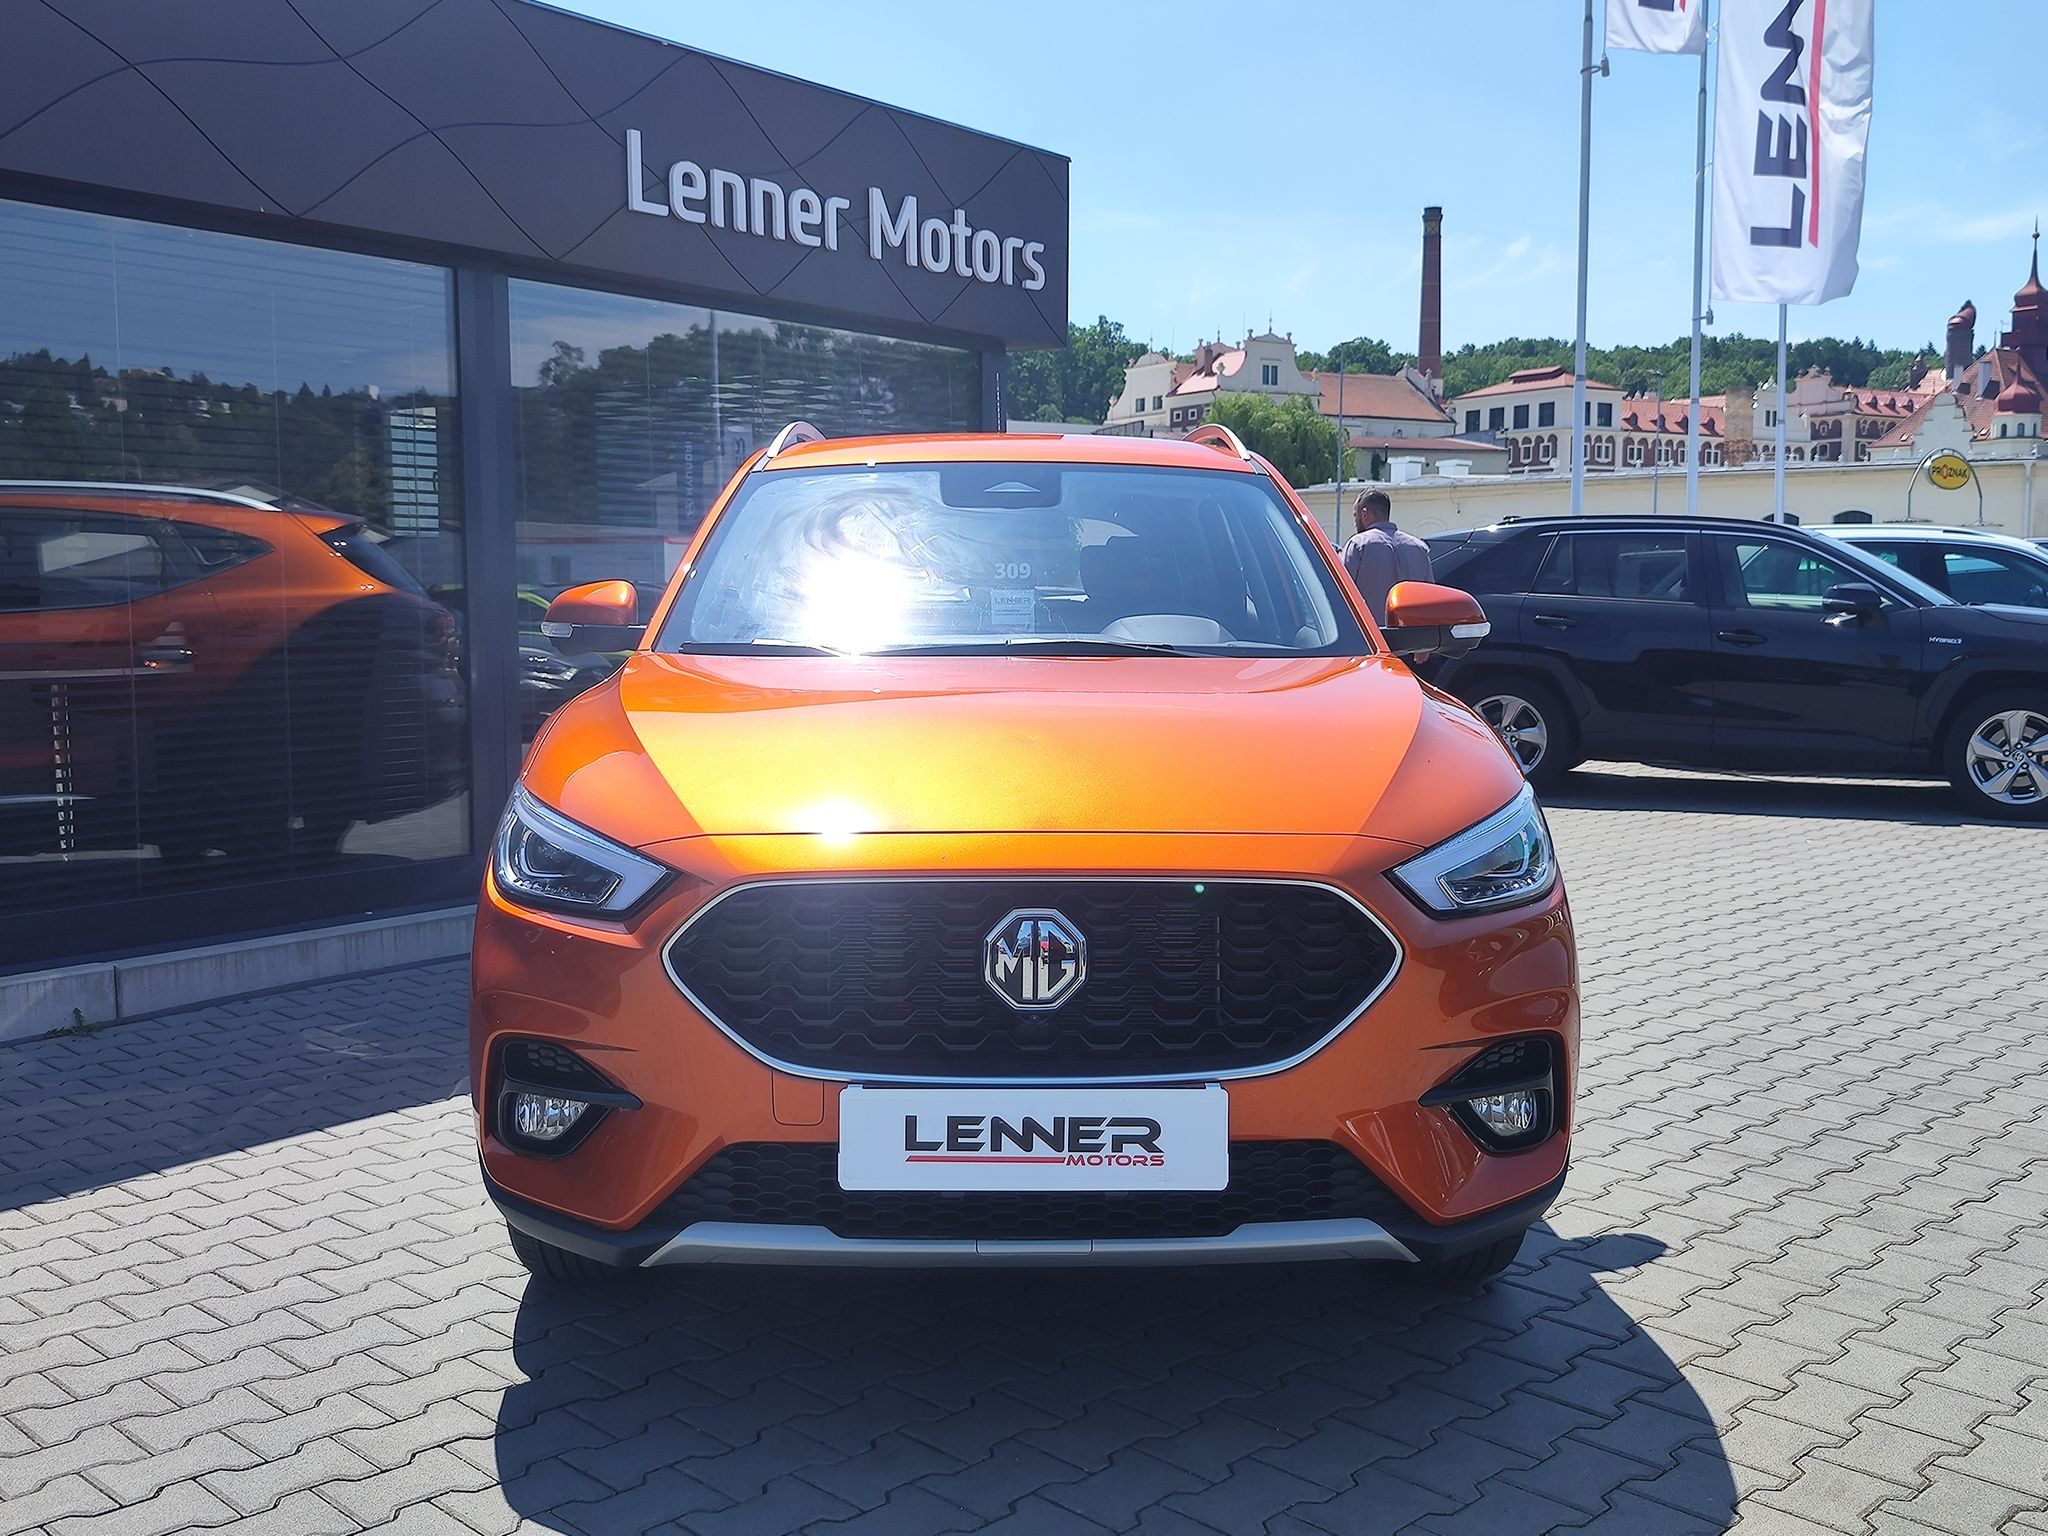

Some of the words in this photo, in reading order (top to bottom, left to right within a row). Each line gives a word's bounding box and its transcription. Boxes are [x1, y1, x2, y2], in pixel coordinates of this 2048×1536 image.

[627, 129, 850, 251] Lenner
[868, 187, 1046, 291] Motors
[995, 562, 1031, 579] 309
[996, 920, 1076, 1000] MG
[904, 1115, 1165, 1153] LENNER
[1066, 1154, 1165, 1167] MOTORS
